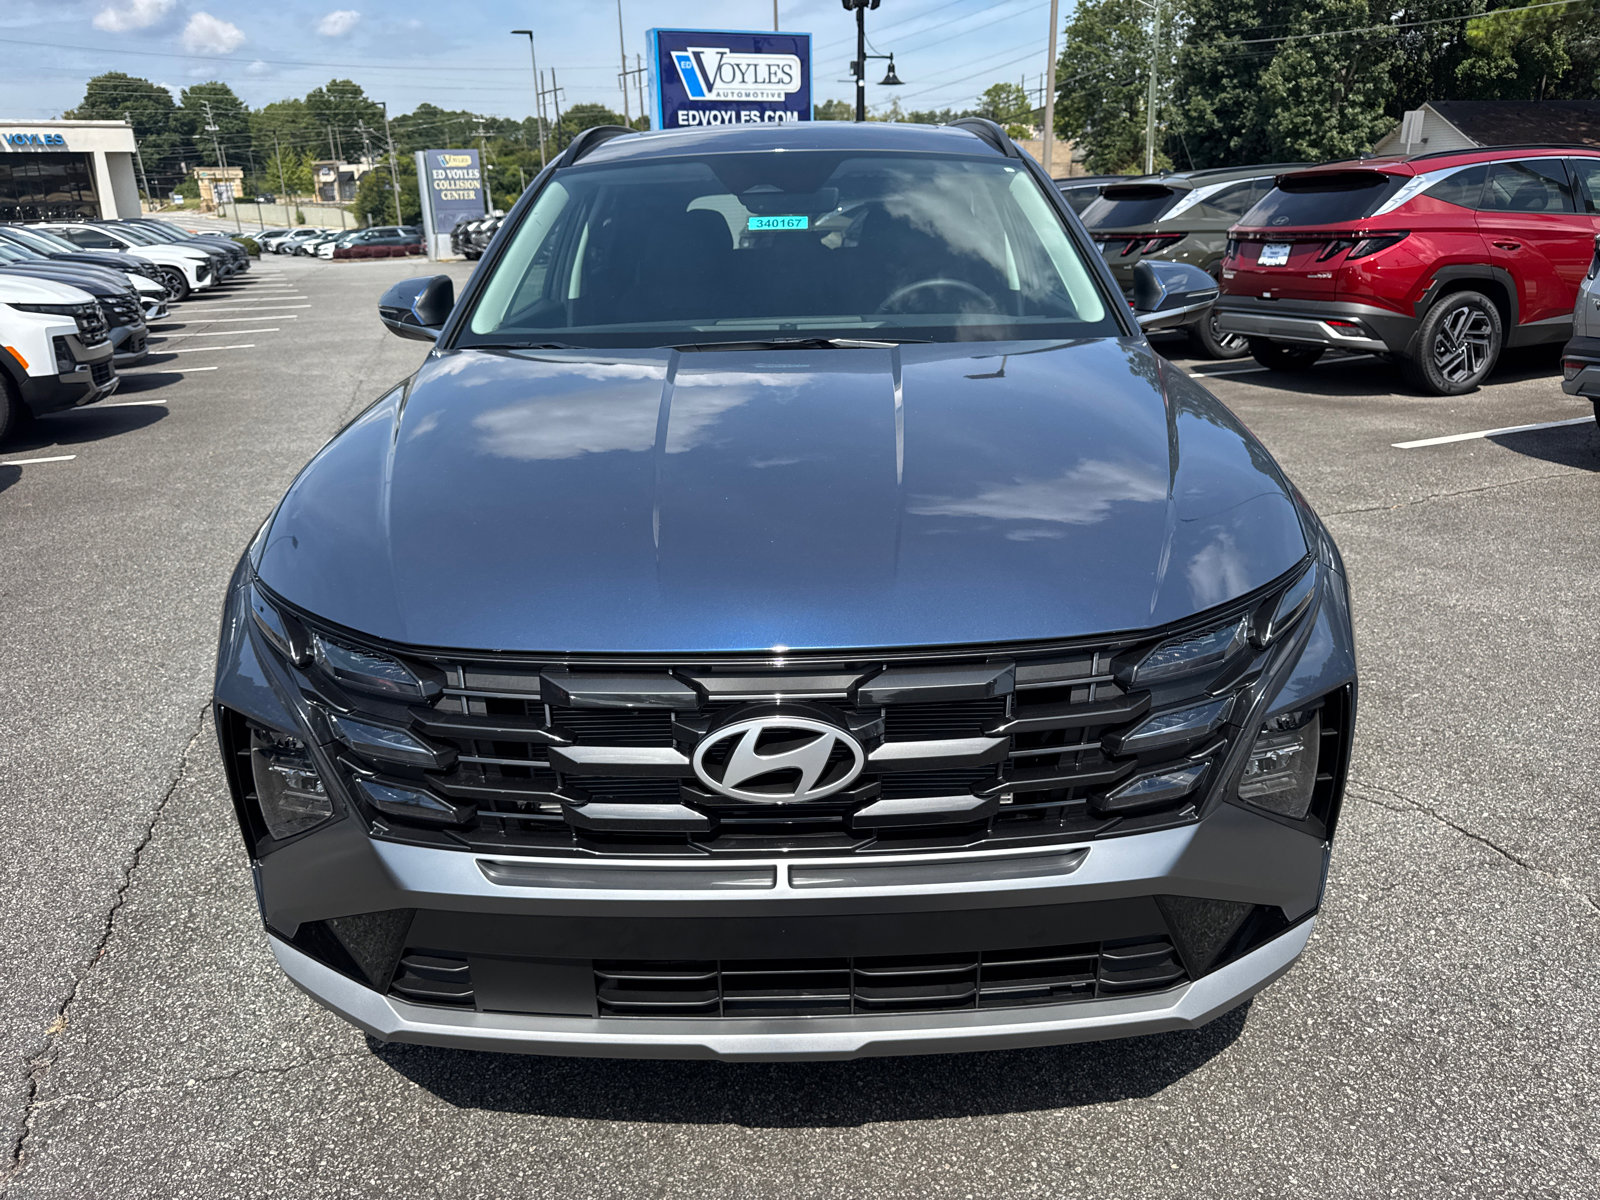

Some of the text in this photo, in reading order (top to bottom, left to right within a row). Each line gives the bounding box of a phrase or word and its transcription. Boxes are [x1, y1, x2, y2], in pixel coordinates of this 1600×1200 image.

[680, 51, 793, 93] ED VOYLES
[677, 110, 799, 126] EDVOYLES.COM
[2, 133, 65, 145] VOYLES
[432, 169, 480, 179] ED VOYLES
[434, 180, 480, 190] COLLISION
[441, 191, 476, 200] CENTER
[756, 219, 802, 228] 340167
